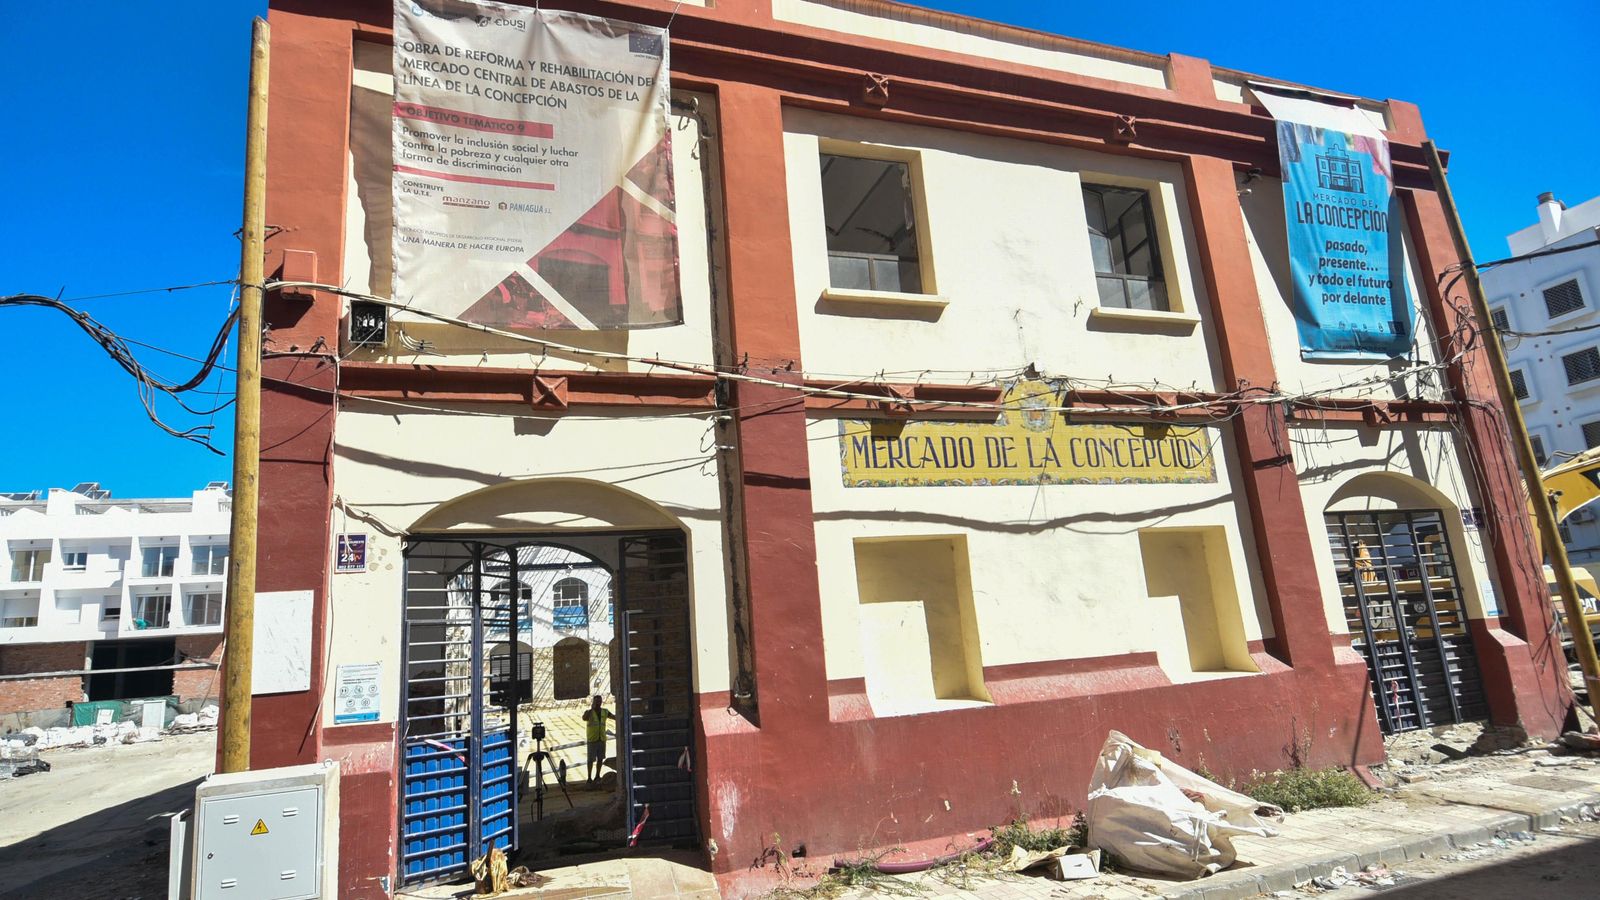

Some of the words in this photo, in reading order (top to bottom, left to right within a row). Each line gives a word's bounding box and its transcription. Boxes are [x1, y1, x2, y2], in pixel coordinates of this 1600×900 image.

[403, 41, 440, 55] OBRA
[445, 46, 461, 57] DE
[465, 50, 525, 70] REFORMA
[528, 61, 536, 71] Y
[540, 62, 633, 86] REHABILITACIÓN
[403, 58, 470, 76] MERCADO
[473, 67, 527, 88] CENTRAL
[531, 77, 546, 89] DE
[550, 80, 604, 98] ABASTOS
[608, 88, 622, 100] DE
[626, 91, 640, 102] LA
[403, 72, 440, 89] LÍNEA
[445, 80, 461, 92] DE
[466, 83, 480, 96] LA
[484, 87, 567, 109] CONCEPCIÓN
[406, 106, 460, 123] OBJETIVO
[402, 126, 451, 142] Promover
[454, 134, 464, 144] la
[467, 136, 509, 150] inclusión
[512, 144, 539, 153] social
[541, 148, 547, 156] y
[550, 145, 578, 157] luchar
[402, 140, 435, 152] contra
[438, 143, 447, 154] la
[450, 147, 491, 159] pobreza
[494, 153, 500, 162] y
[503, 154, 547, 166] cualquier
[550, 159, 569, 167] otra
[402, 149, 433, 163] forma
[436, 155, 449, 165] de
[452, 157, 522, 174] discriminación
[402, 180, 444, 192] CONSTRUYE
[442, 195, 491, 206] manzano
[509, 202, 544, 214] PANIAGUA
[1313, 192, 1357, 206] MERCADO
[1362, 199, 1373, 207] DE
[1296, 201, 1314, 224] LA
[1316, 203, 1389, 233] CONCEPCIÓN
[402, 236, 420, 244] UNA
[422, 238, 456, 249] MANERA
[469, 243, 494, 251] HACER
[495, 244, 524, 253] EUROPA
[1325, 240, 1368, 255] pasado,
[1308, 274, 1315, 287] y
[1317, 272, 1344, 286] todo
[1346, 274, 1356, 287] el
[1358, 275, 1393, 289] futuro
[1322, 292, 1341, 305] por
[1343, 291, 1386, 306] delante
[851, 435, 975, 469] MERCADO
[984, 435, 1018, 469] DE
[1025, 436, 1062, 469] LA
